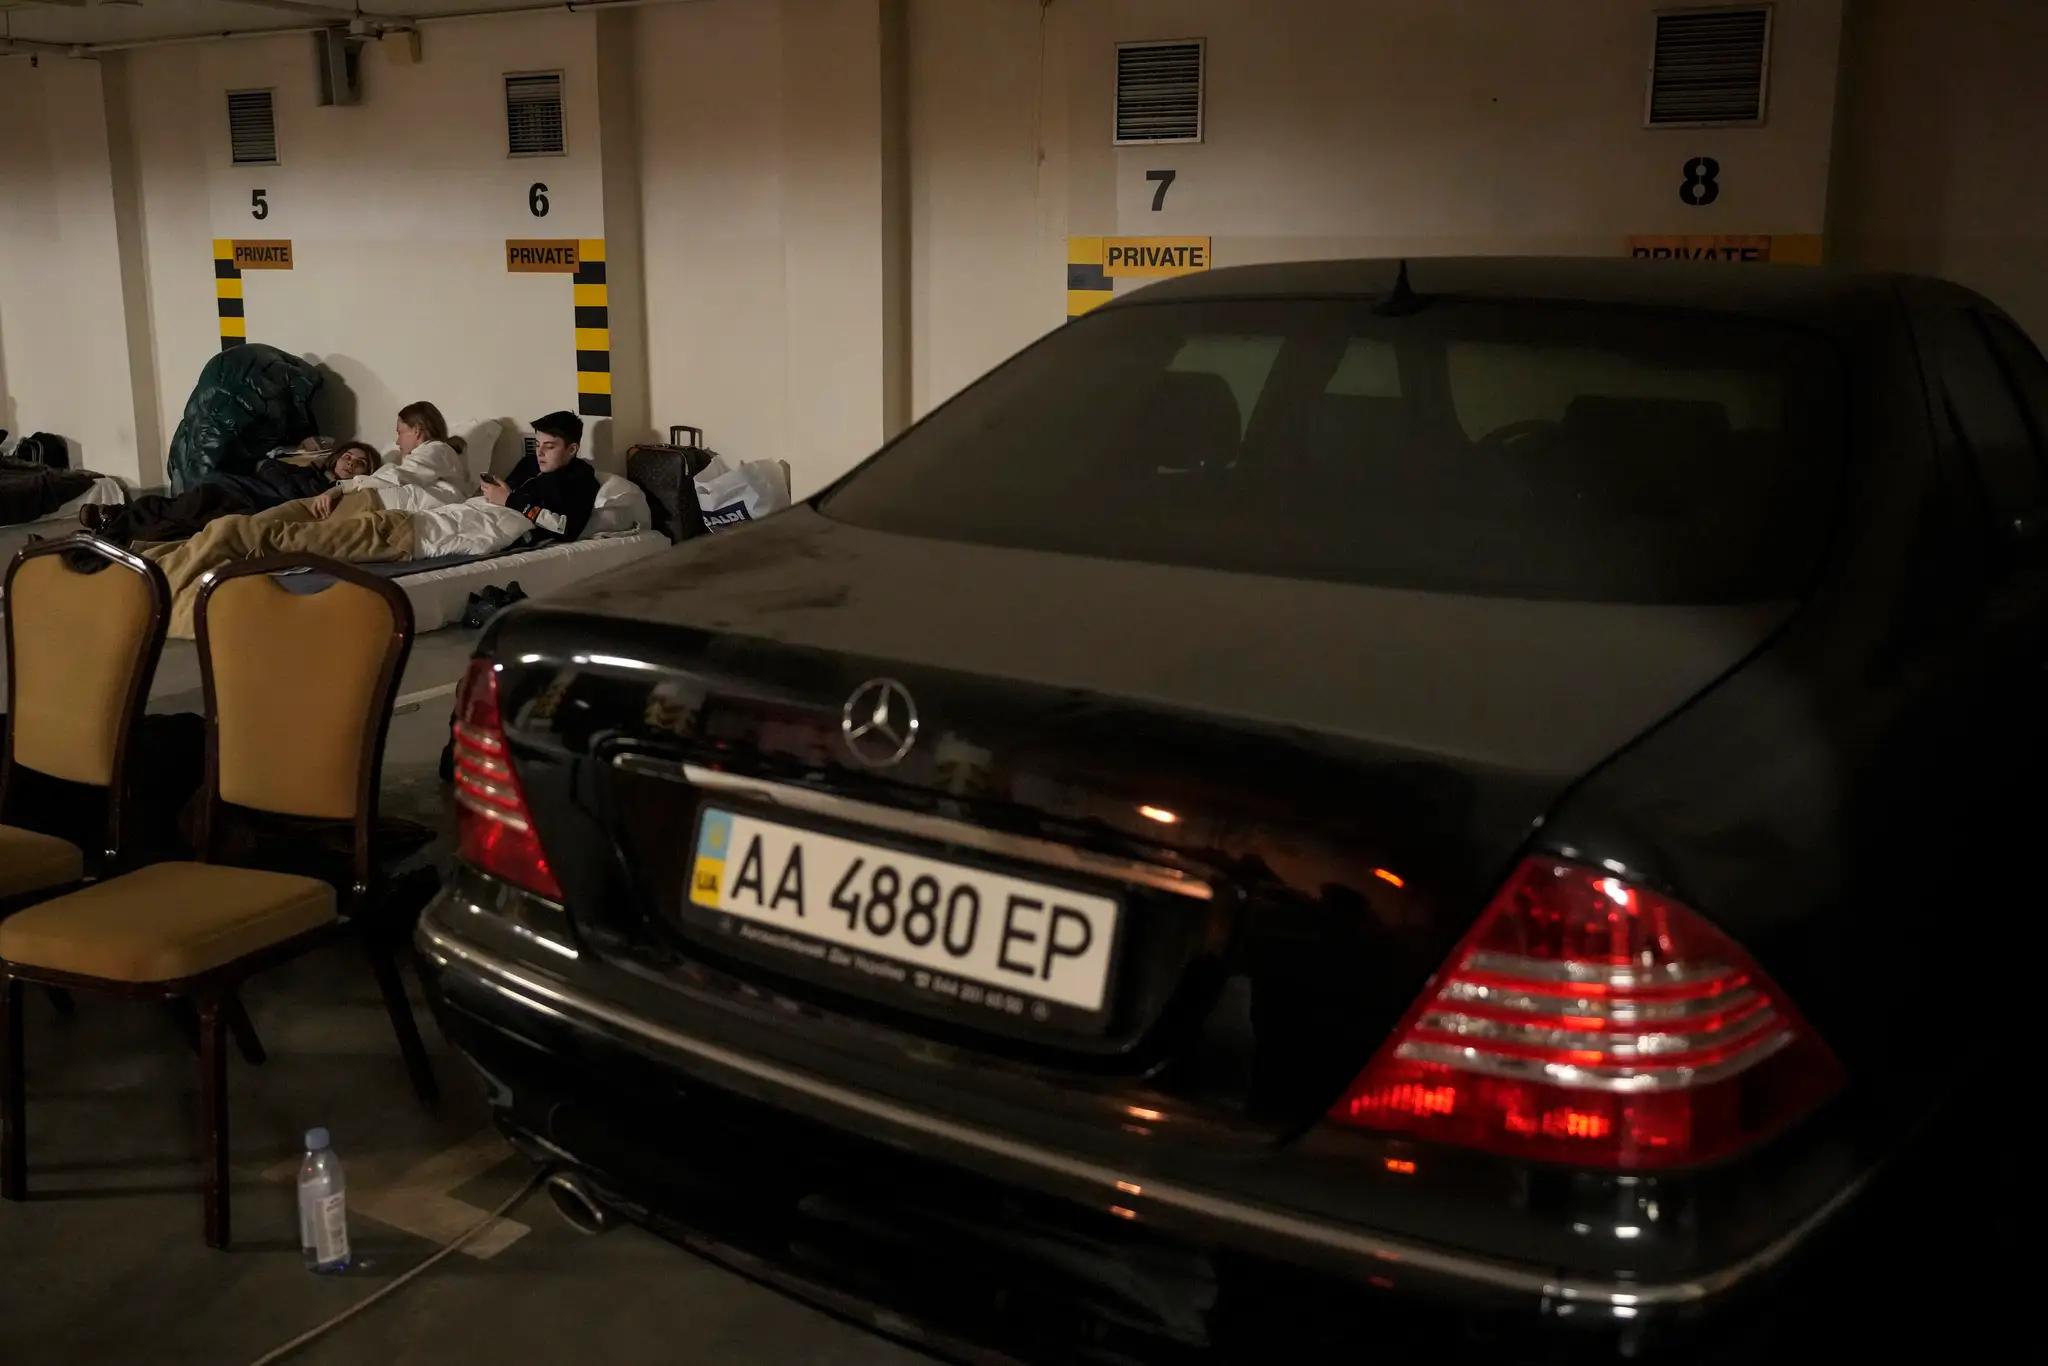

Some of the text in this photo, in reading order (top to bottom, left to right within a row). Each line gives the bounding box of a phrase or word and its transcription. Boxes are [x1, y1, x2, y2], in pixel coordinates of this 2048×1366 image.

[1146, 169, 1176, 212] 7
[1679, 157, 1720, 205] 8
[252, 189, 268, 220] 5
[529, 182, 549, 217] 6
[235, 247, 289, 262] PRIVATE
[510, 247, 575, 264] PRIVATE
[1108, 246, 1204, 267] PRIVATE
[696, 870, 718, 893] UA
[731, 834, 805, 917] AA
[829, 857, 980, 957] 4880
[998, 893, 1092, 981] EP
